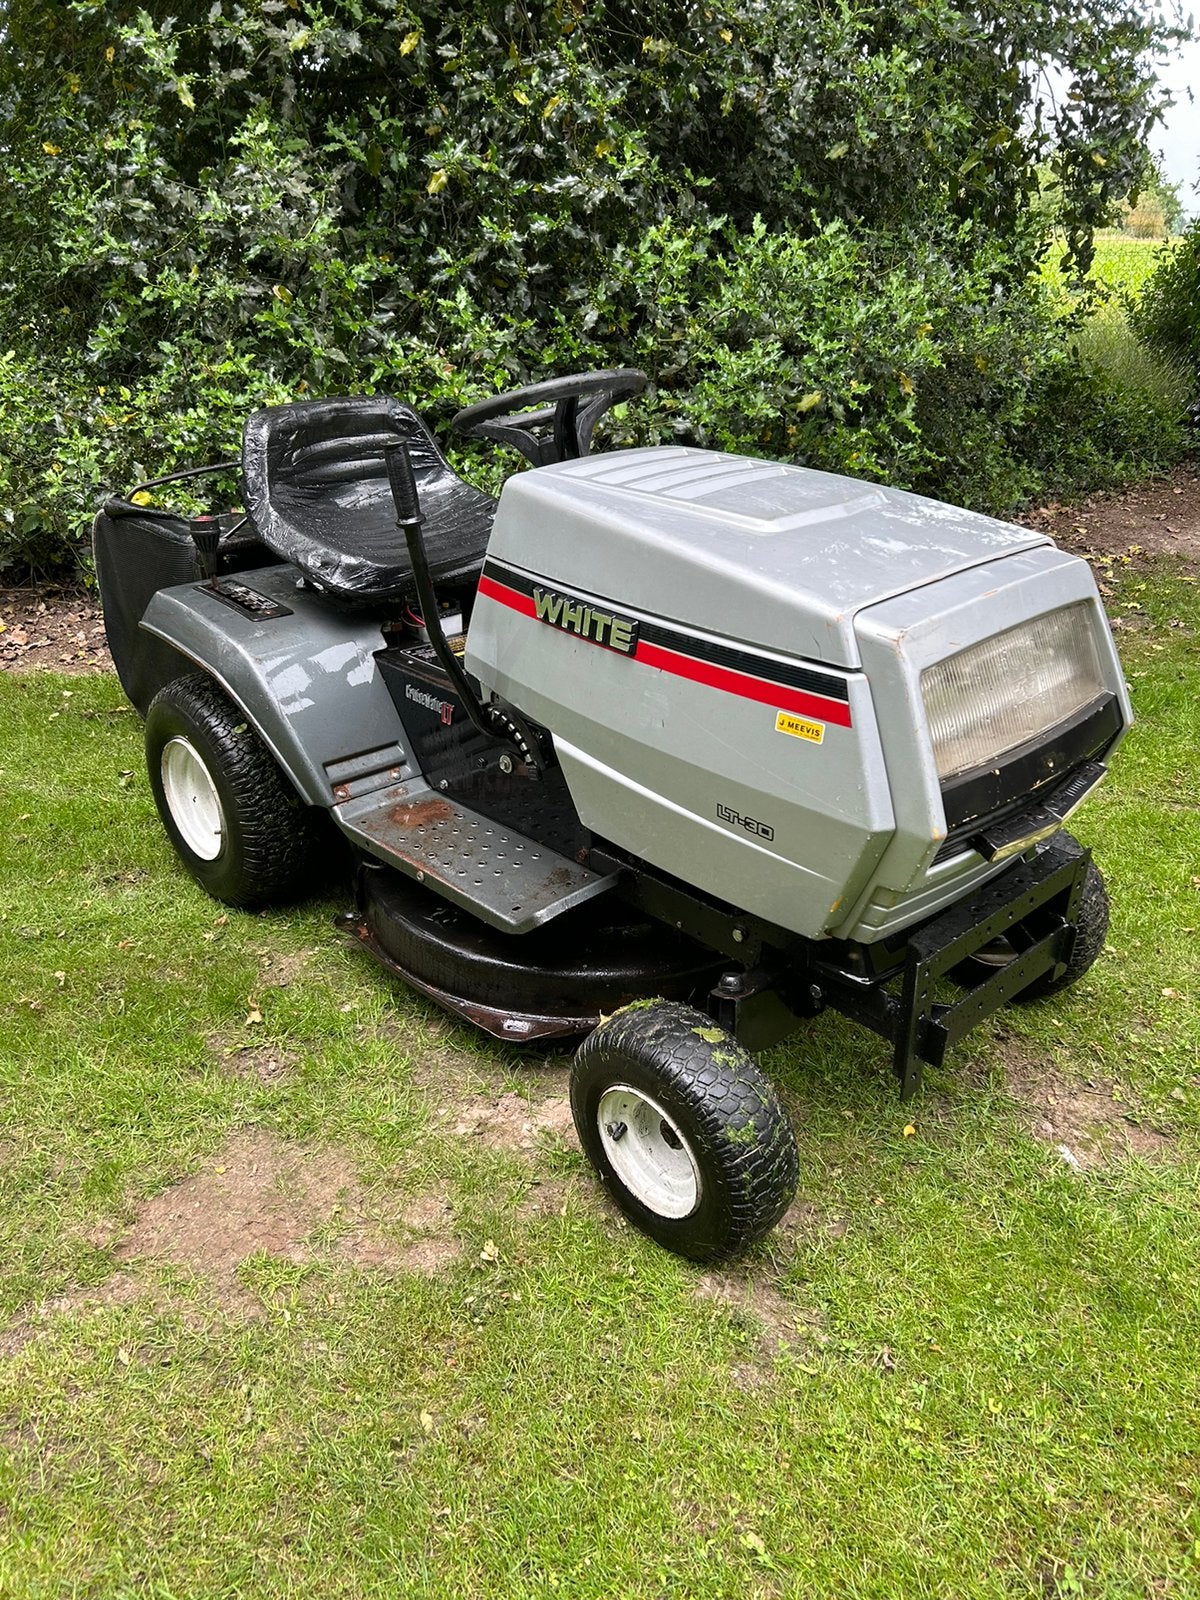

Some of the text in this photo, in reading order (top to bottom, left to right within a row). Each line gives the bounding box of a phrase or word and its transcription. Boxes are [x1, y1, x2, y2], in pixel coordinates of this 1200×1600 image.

[533, 587, 638, 653] WHITE
[787, 721, 821, 737] MEEVIS
[717, 803, 774, 841] LT-30
